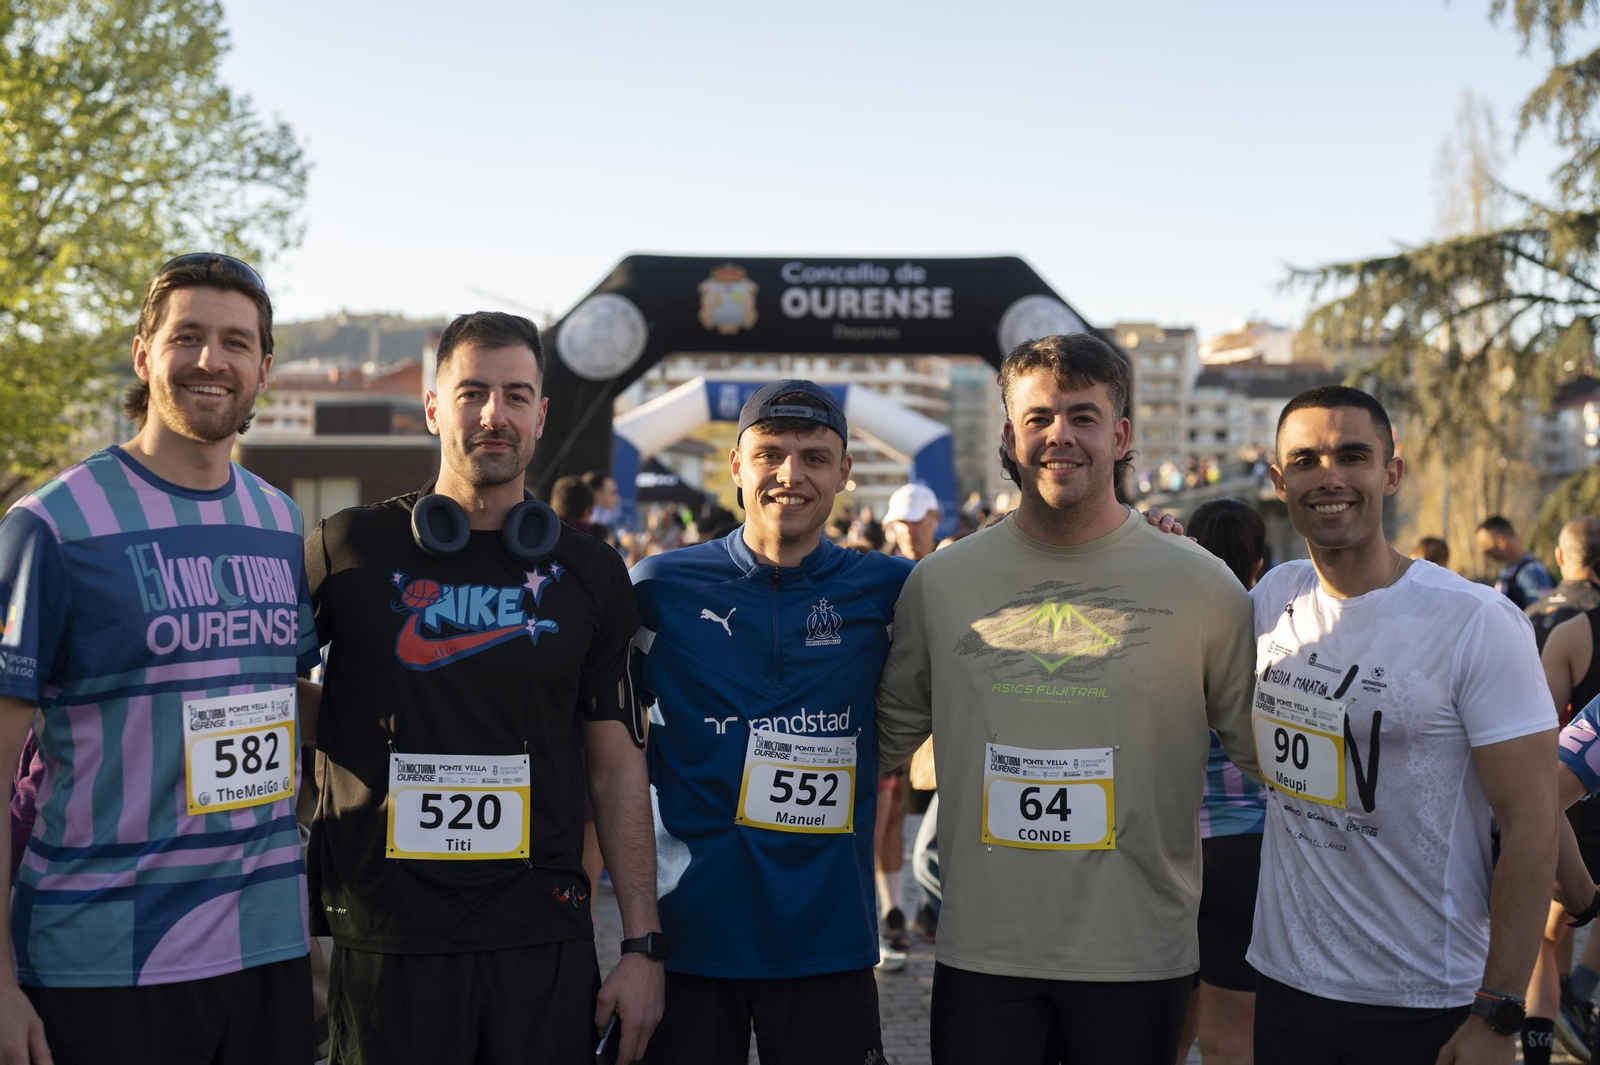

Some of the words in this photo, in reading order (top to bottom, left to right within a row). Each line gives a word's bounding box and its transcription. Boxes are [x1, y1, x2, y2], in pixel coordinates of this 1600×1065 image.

[782, 262, 889, 284] Concello
[895, 262, 926, 284] de
[782, 287, 952, 319] OURENSE
[424, 584, 525, 630] NIKE
[147, 609, 298, 655] OURENSE
[991, 683, 1034, 694] ASICS
[1036, 685, 1109, 698] FUJITRAIL
[1268, 669, 1291, 686] MEDIA
[1293, 676, 1328, 696] MARATÓN
[228, 705, 249, 713] PONTE
[1256, 700, 1275, 714] OURENSE
[1276, 698, 1292, 708] PONTE
[1294, 703, 1309, 712] VELLA
[749, 706, 850, 733] randstad
[216, 732, 279, 778] 582
[754, 749, 791, 760] OURENSE
[1274, 727, 1309, 770] 90
[397, 774, 435, 782] OURENSE
[990, 764, 1020, 774] OURENSE
[217, 780, 278, 802] TheMeiGo
[770, 770, 838, 806] 552
[1276, 770, 1306, 792] Meupi
[420, 794, 501, 830] 520
[1020, 787, 1071, 821] 64
[776, 812, 826, 826] Manuel
[446, 839, 471, 850] Titi
[1018, 828, 1070, 842] CONDE
